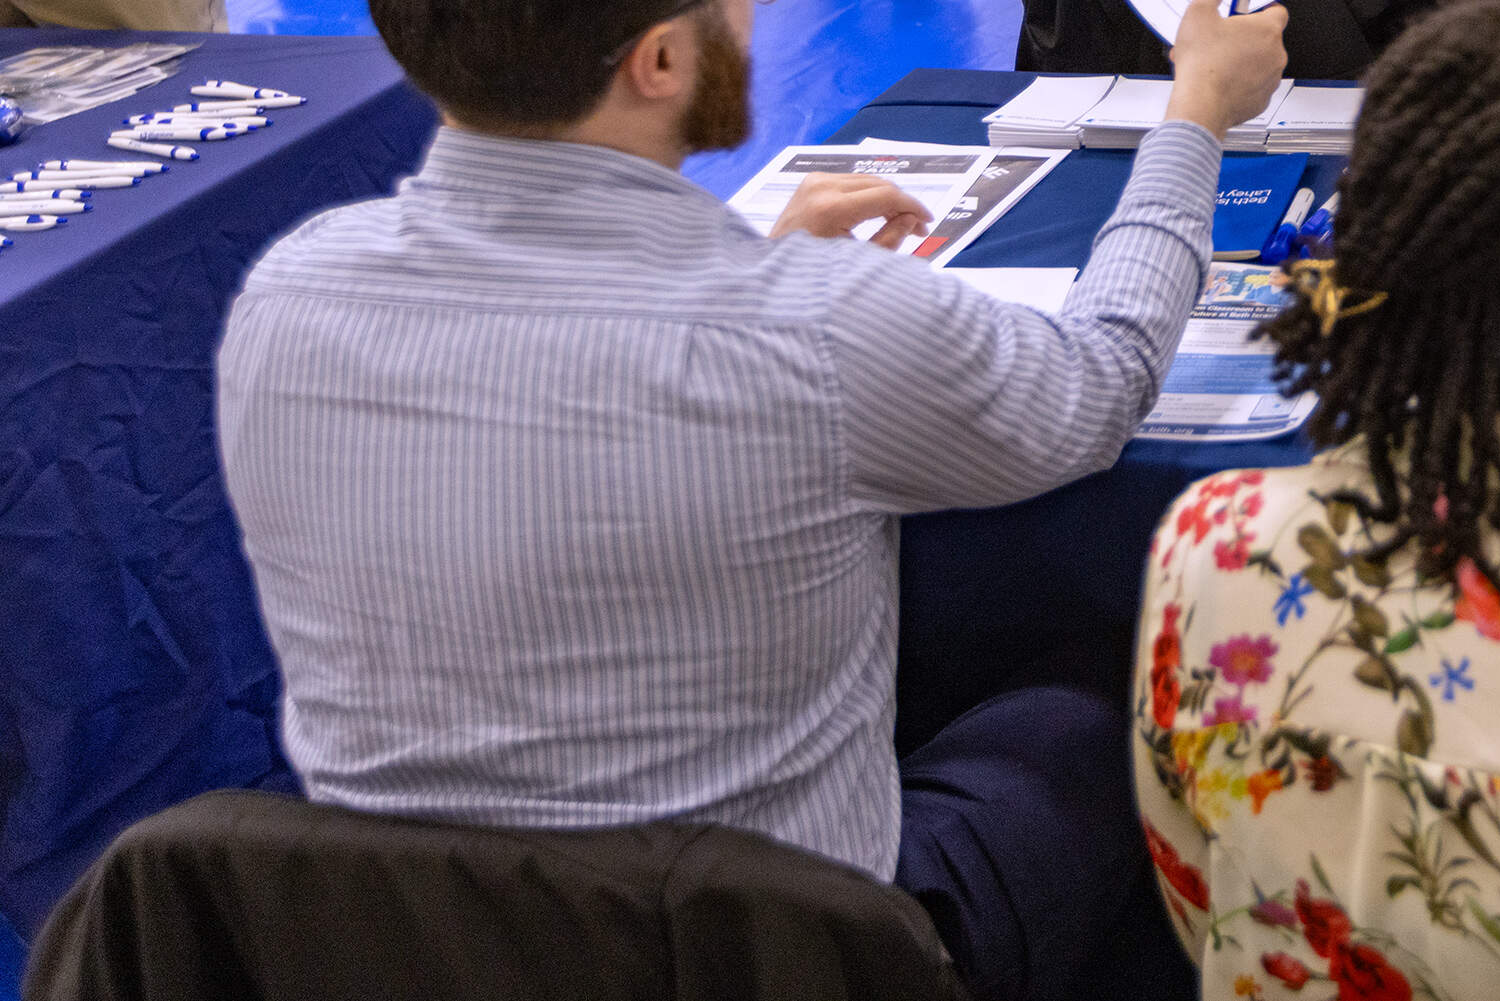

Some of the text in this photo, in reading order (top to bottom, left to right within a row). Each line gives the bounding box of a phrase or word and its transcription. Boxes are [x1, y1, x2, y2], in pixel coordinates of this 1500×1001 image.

[854, 160, 910, 169] MEGA
[1227, 188, 1272, 198] Lahey
[1235, 196, 1269, 206] Beth
